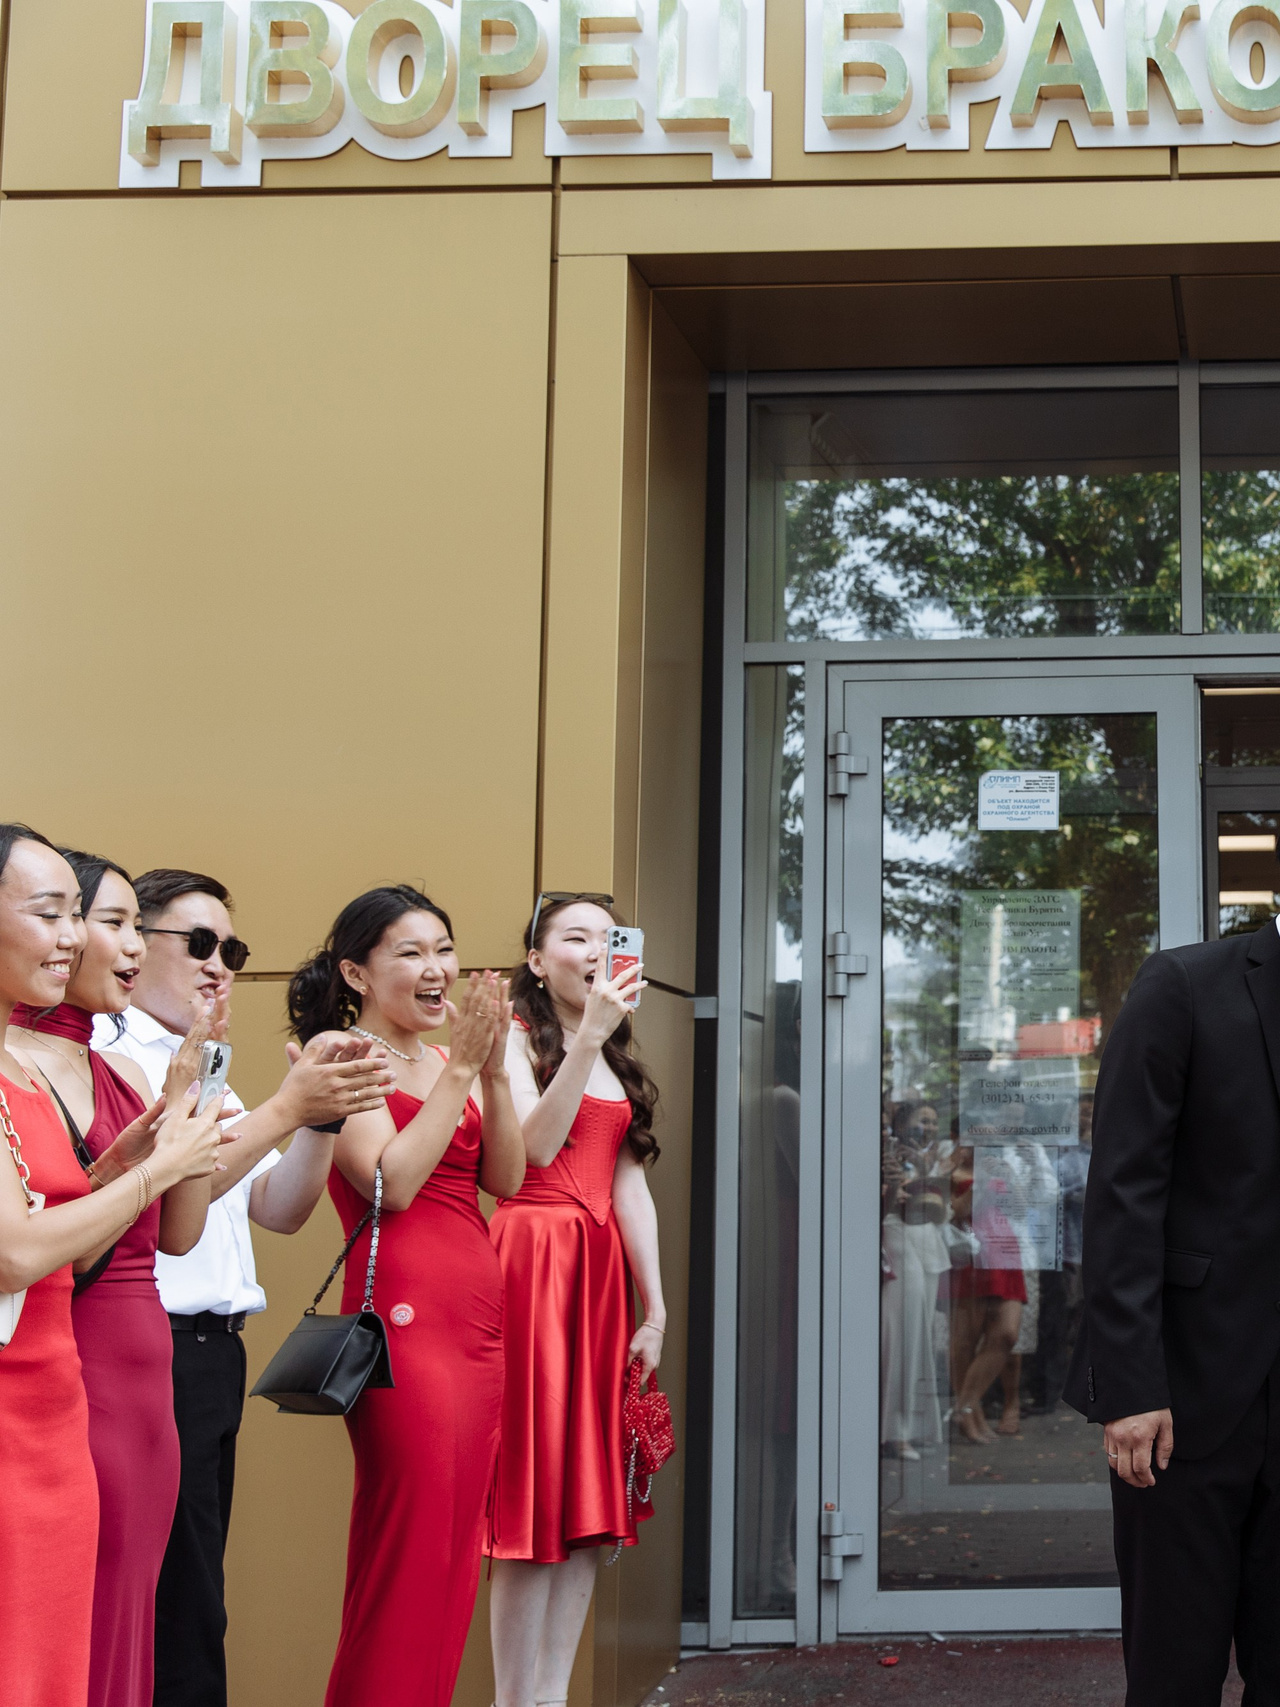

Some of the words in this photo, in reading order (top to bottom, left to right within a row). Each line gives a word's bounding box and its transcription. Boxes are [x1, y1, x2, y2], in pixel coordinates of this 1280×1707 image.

[127, 0, 753, 167] ДВОРЕЦ
[1033, 895, 1060, 904] ЗАГС
[978, 1079, 1020, 1090] Телефон
[981, 1093, 1012, 1105] (3012)
[1014, 1093, 1056, 1103] 21-65-31
